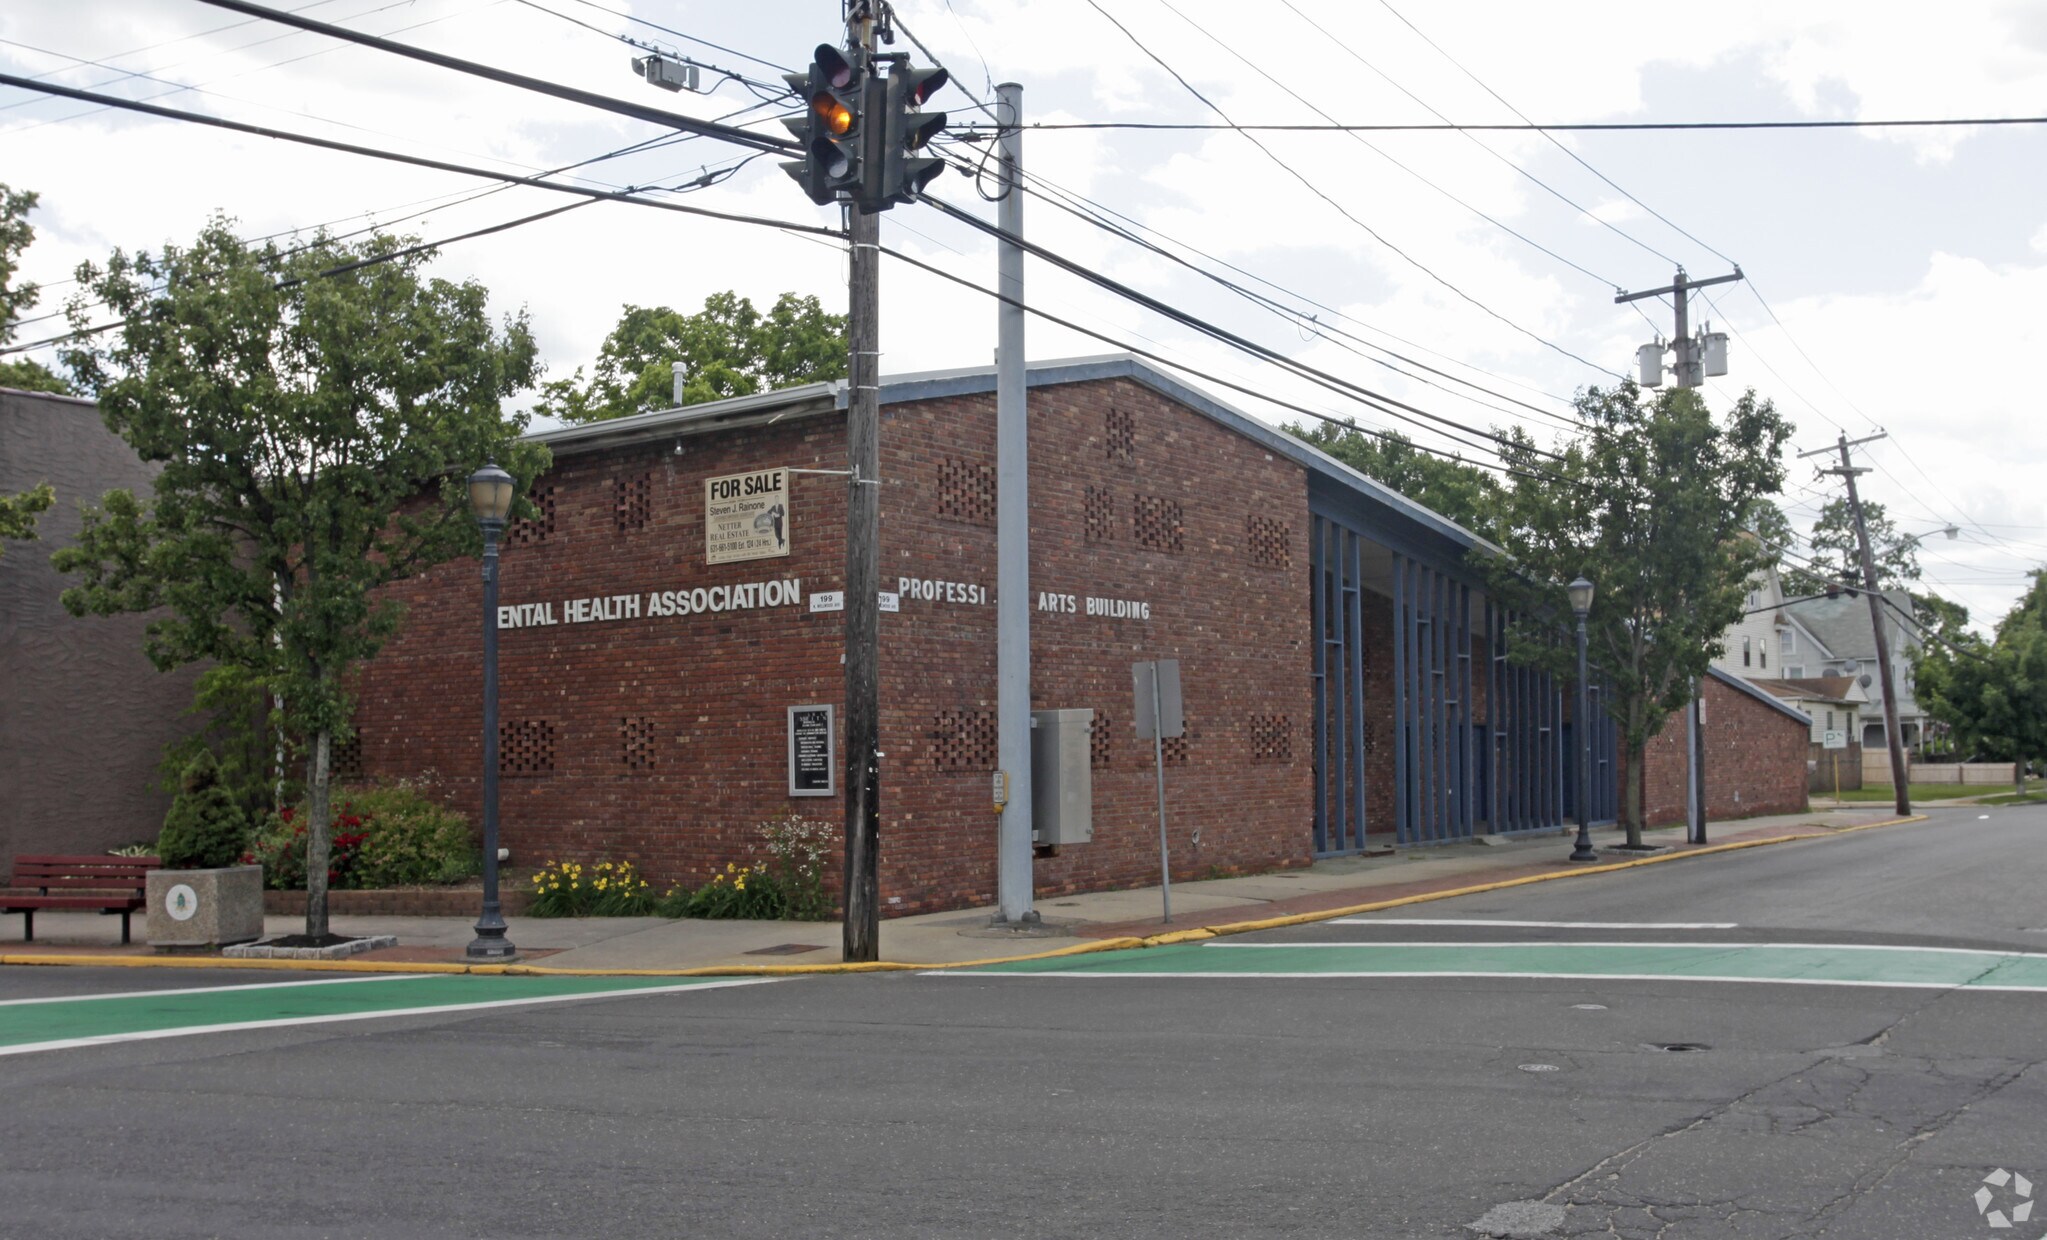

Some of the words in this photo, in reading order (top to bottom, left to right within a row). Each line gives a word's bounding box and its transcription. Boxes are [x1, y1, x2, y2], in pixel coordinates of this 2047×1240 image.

[711, 478, 740, 500] FOR
[744, 472, 782, 496] SALE
[710, 506, 731, 516] Steven
[739, 501, 765, 511] Rainone
[710, 532, 726, 541] REAL
[727, 529, 749, 539] ESTATE
[718, 522, 742, 531] NETTER
[498, 602, 558, 629] ENTAL
[564, 594, 640, 624] HEALTH
[647, 579, 800, 617] ASSOCIATION
[899, 577, 986, 605] PROFESSI
[1038, 592, 1076, 614] ARTS
[1086, 597, 1150, 620] BUILDING
